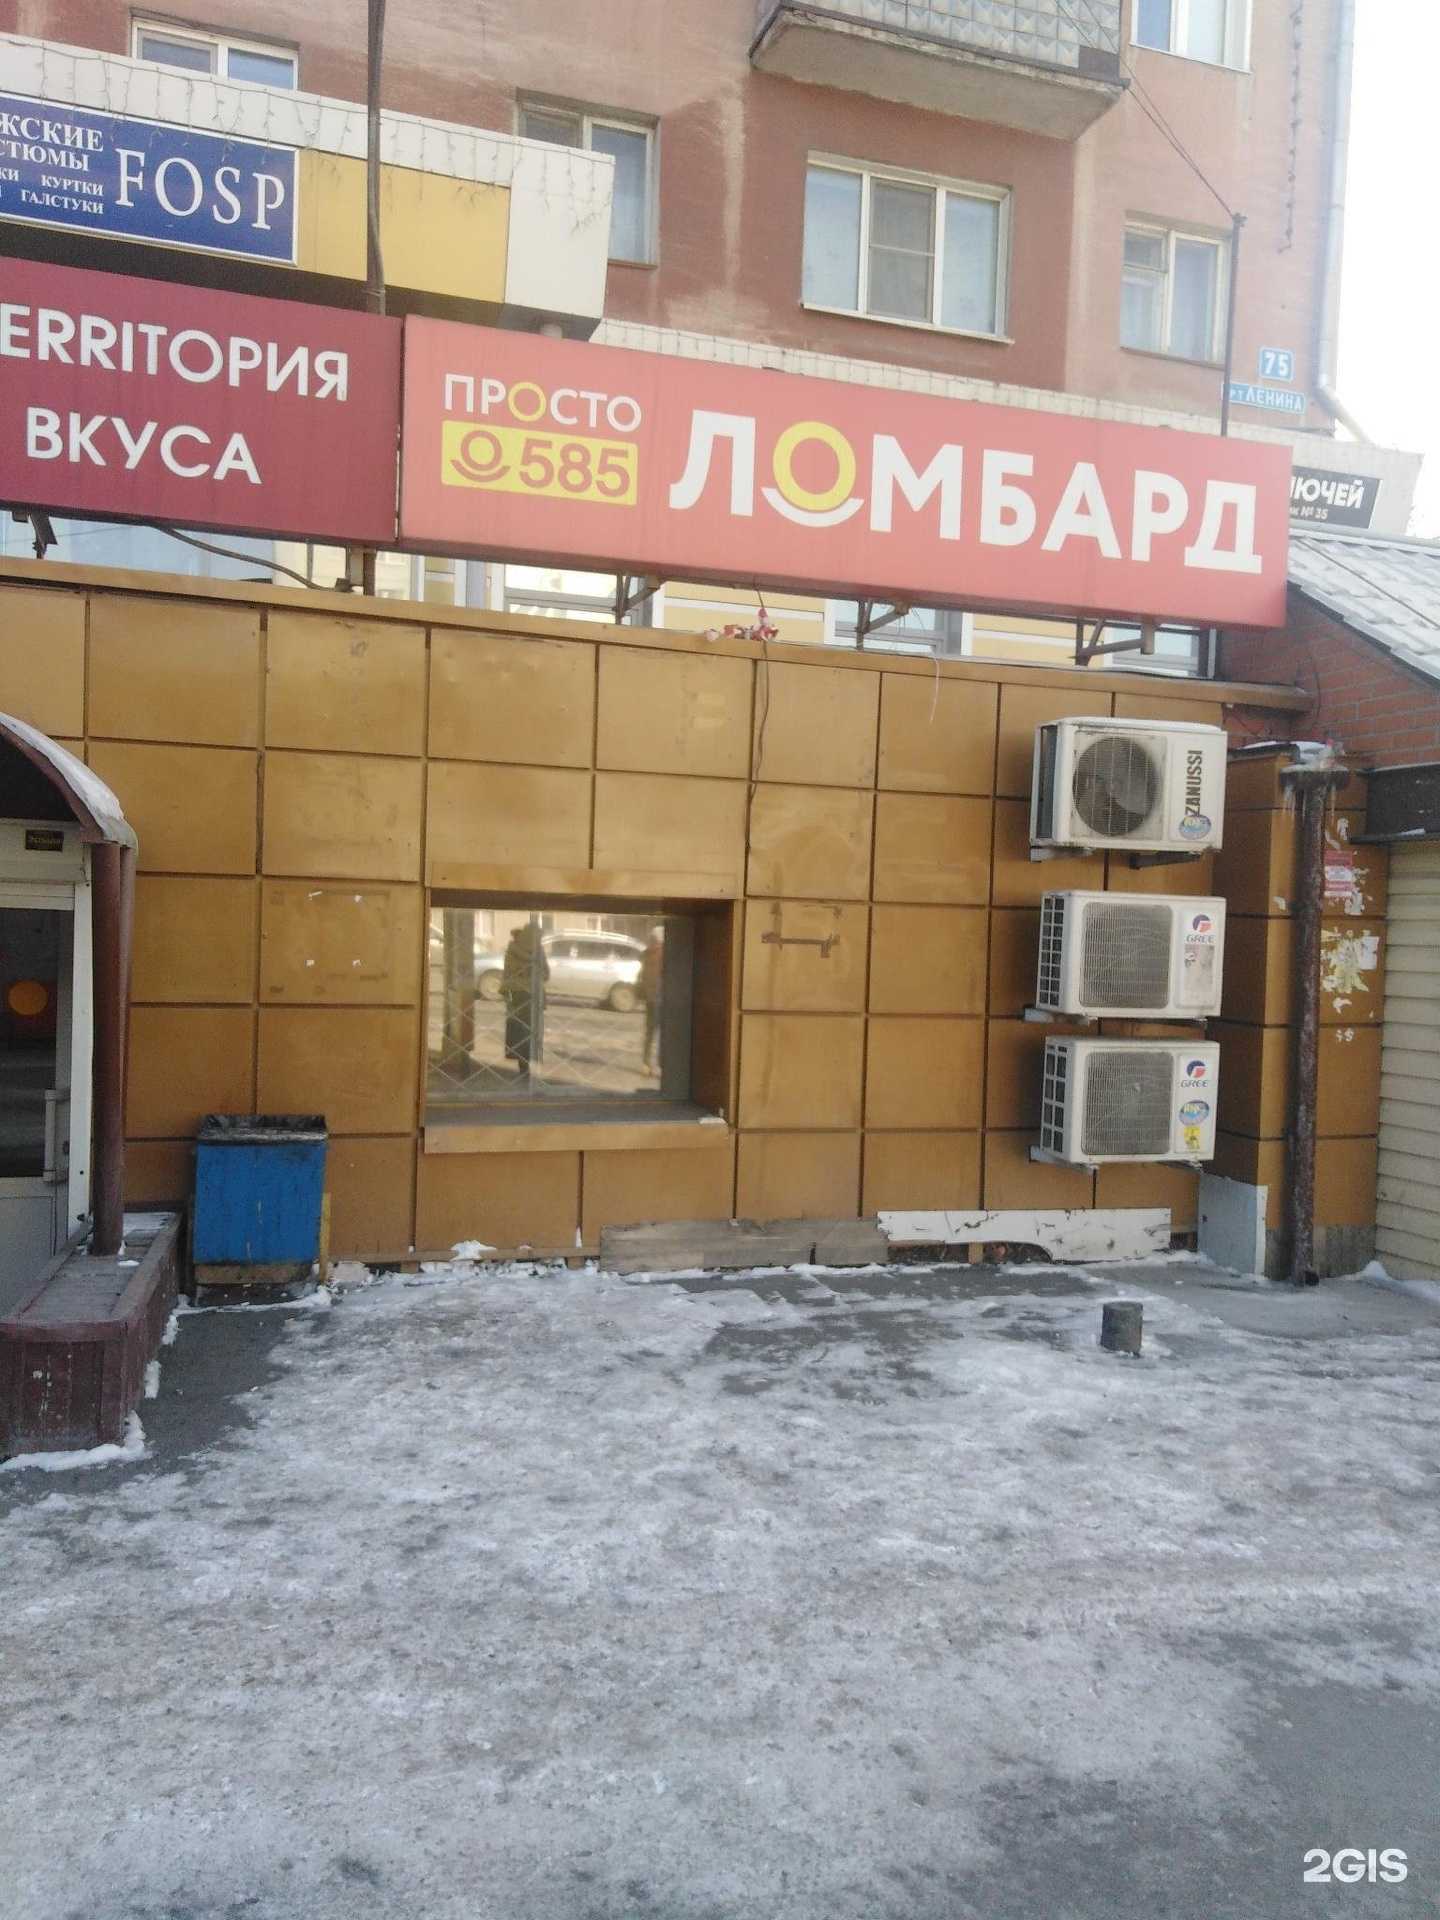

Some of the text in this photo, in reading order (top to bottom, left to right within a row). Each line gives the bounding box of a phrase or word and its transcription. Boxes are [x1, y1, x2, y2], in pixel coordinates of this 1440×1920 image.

[21, 188, 104, 214] ГАЛСТУКИ
[41, 174, 104, 196] КУРТКИ
[115, 147, 286, 231] FOSP
[1263, 351, 1289, 377] 75
[444, 373, 642, 432] ПРОСТО
[1246, 385, 1303, 412] ЛЕНИНА
[26, 406, 262, 484] ВКУСА
[519, 437, 630, 497] 585
[669, 408, 1263, 574] ЛОМБАРД
[1184, 749, 1203, 818] ZANUSSI
